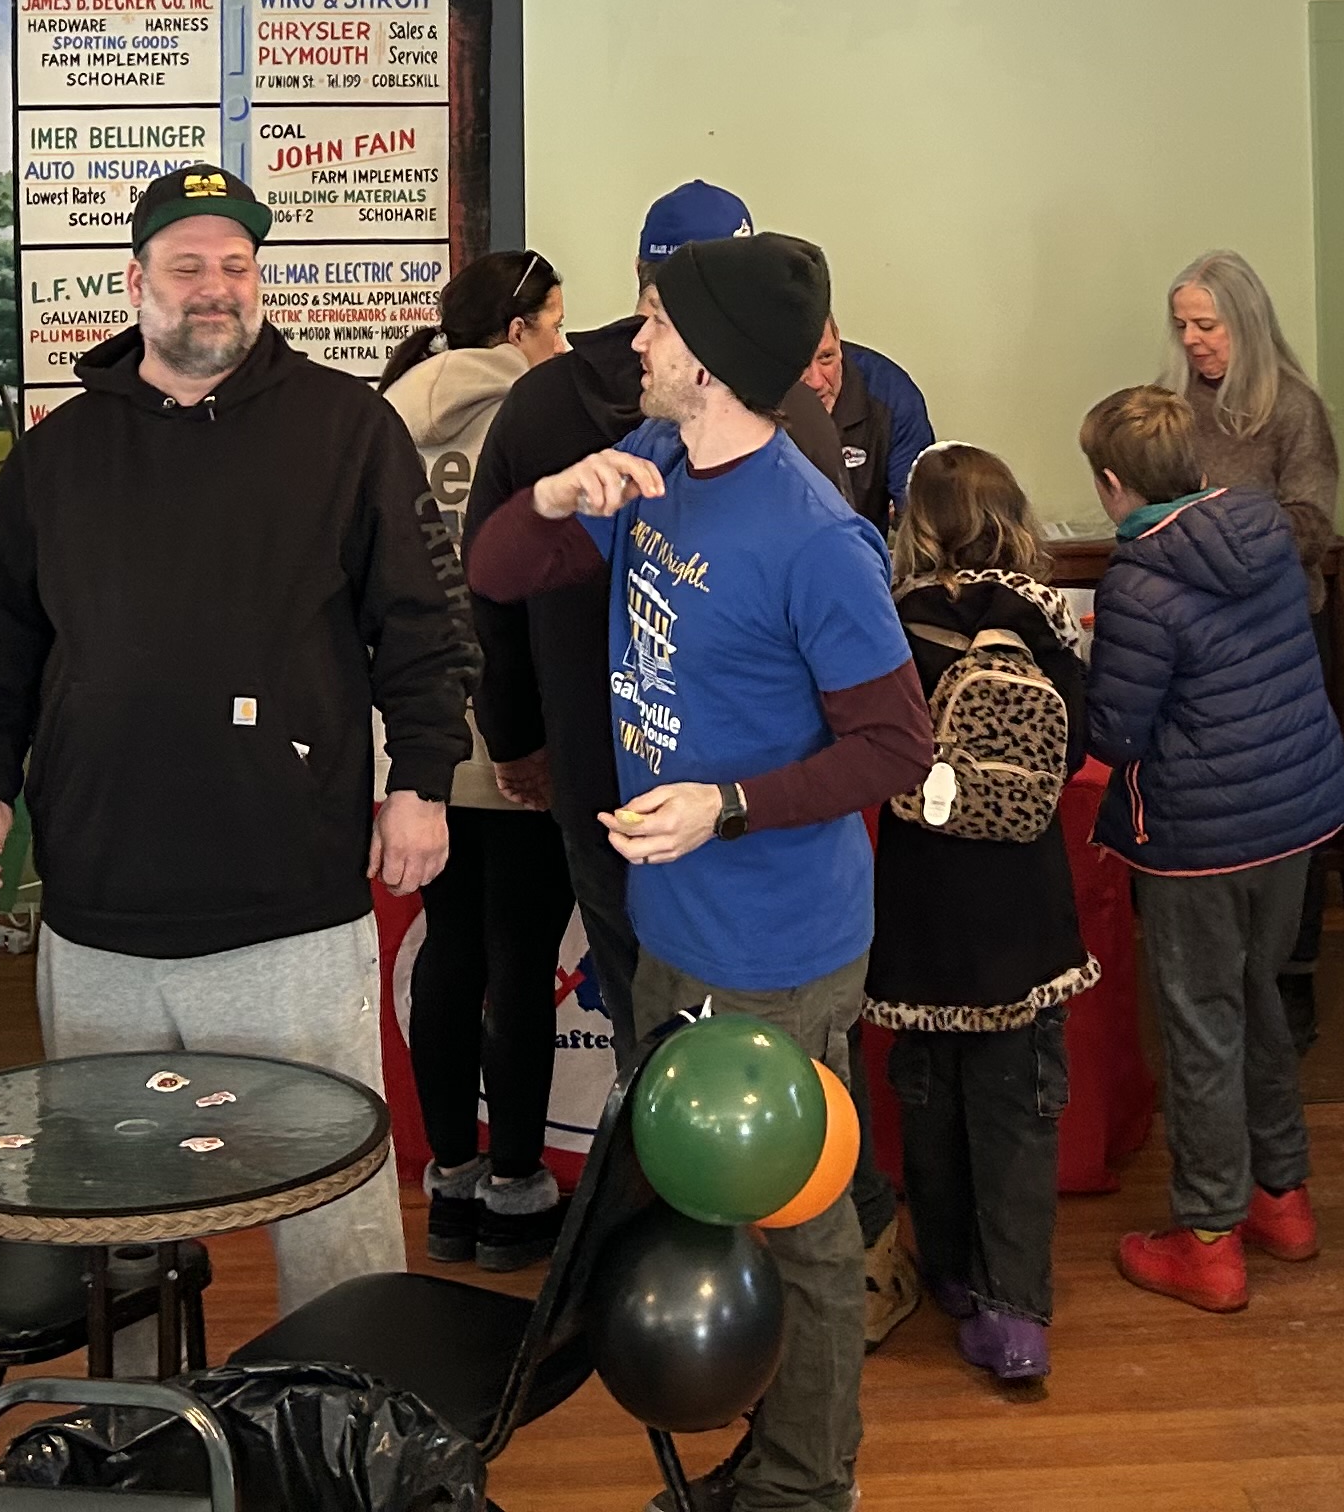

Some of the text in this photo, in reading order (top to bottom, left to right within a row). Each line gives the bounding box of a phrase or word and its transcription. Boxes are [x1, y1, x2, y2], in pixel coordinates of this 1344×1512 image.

[27, 18, 209, 33] HARDWARE HARNESS
[258, 21, 438, 41] CHRYSLER Sales &
[53, 35, 179, 50] SPORTING GOODS
[41, 53, 190, 67] FARM IMPLEMENTS
[258, 45, 438, 66] PLYMOUTH Service
[66, 72, 166, 86] SCHOHARIE
[256, 75, 265, 88] 17
[268, 75, 300, 89] UNION
[372, 74, 440, 88] COBLESKILL
[31, 125, 206, 149] IMER BELLINGER
[259, 123, 306, 138] COAL
[268, 127, 415, 171] JOHN FAIN
[24, 159, 205, 180] AUTO INSURAN
[311, 168, 438, 184] FARM IMPLEMENTS
[26, 186, 68, 205] Lowest
[72, 186, 106, 205] Rates
[268, 188, 426, 205] BUILDING MATERIALS
[358, 207, 437, 222] SCHOHARIE
[326, 262, 393, 283] ELECTRIC
[400, 261, 442, 282] SHOP
[262, 291, 440, 306] RADIOS & SMALL APPLIANCES
[41, 310, 128, 325] GALVANIZED
[308, 307, 386, 323] REFRIGERATORS
[390, 310, 398, 321] &
[399, 307, 440, 322] RANGES
[324, 346, 379, 360] CENTRAL
